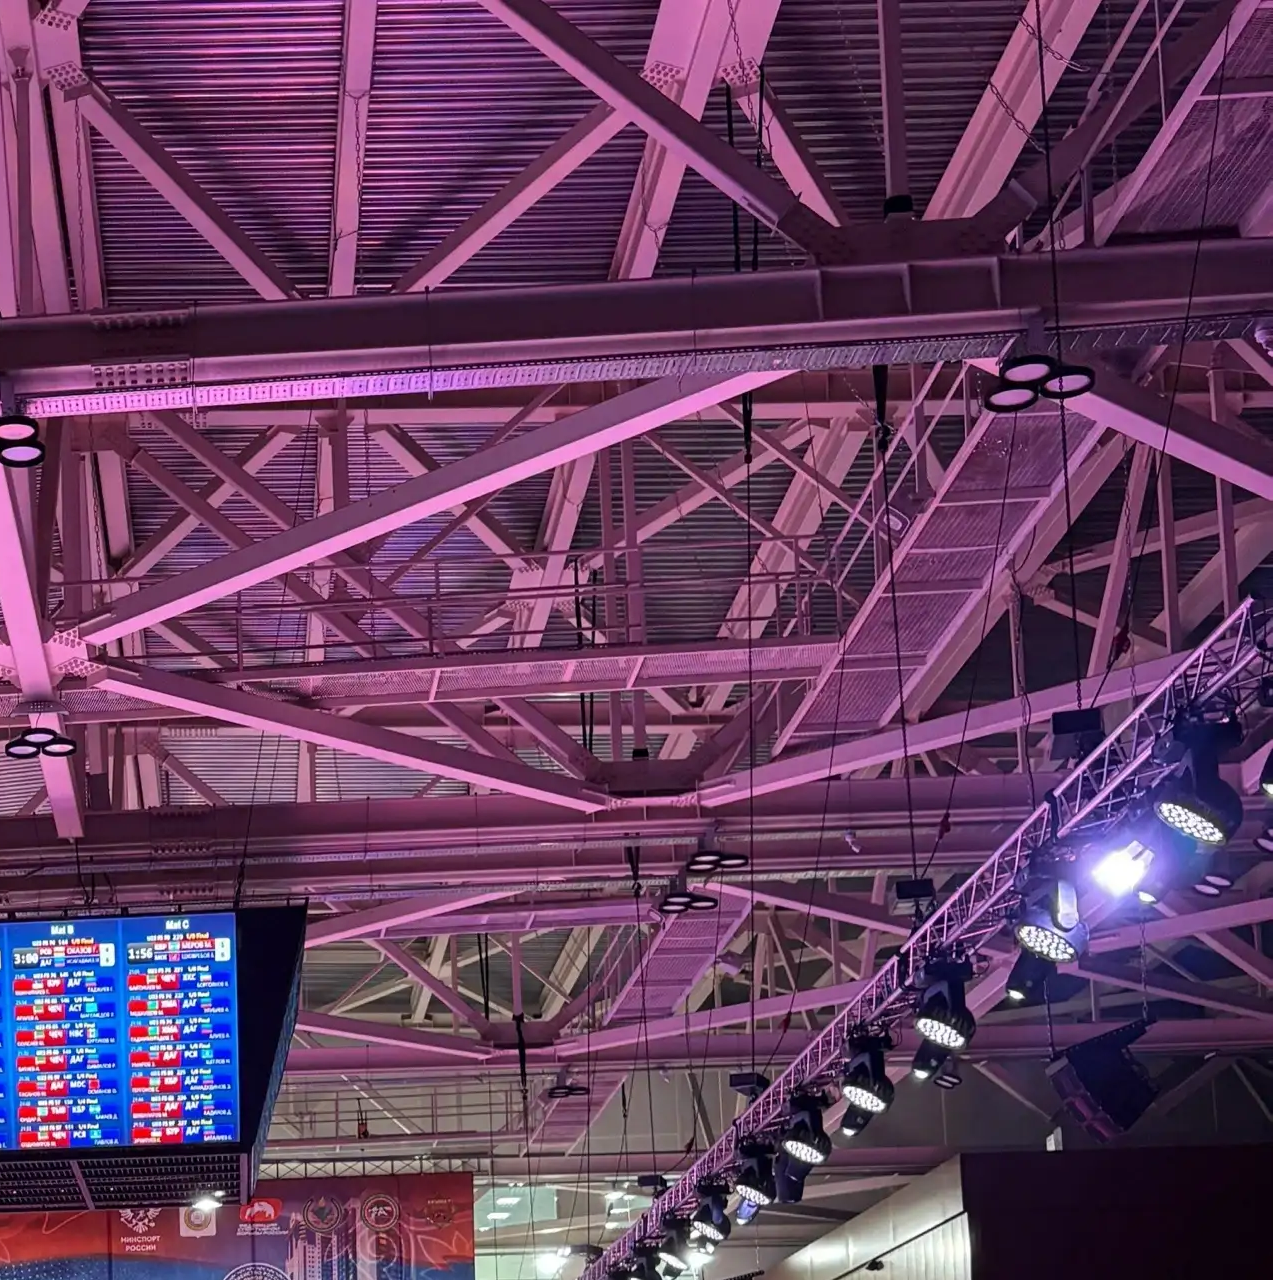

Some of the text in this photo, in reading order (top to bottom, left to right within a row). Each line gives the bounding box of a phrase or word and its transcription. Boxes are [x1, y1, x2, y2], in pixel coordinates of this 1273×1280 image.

[128, 948, 153, 959] 1:56
[13, 954, 39, 964] 3:00
[121, 1235, 161, 1244] МИНСПОРТ
[125, 1244, 157, 1252] РОССИИ
